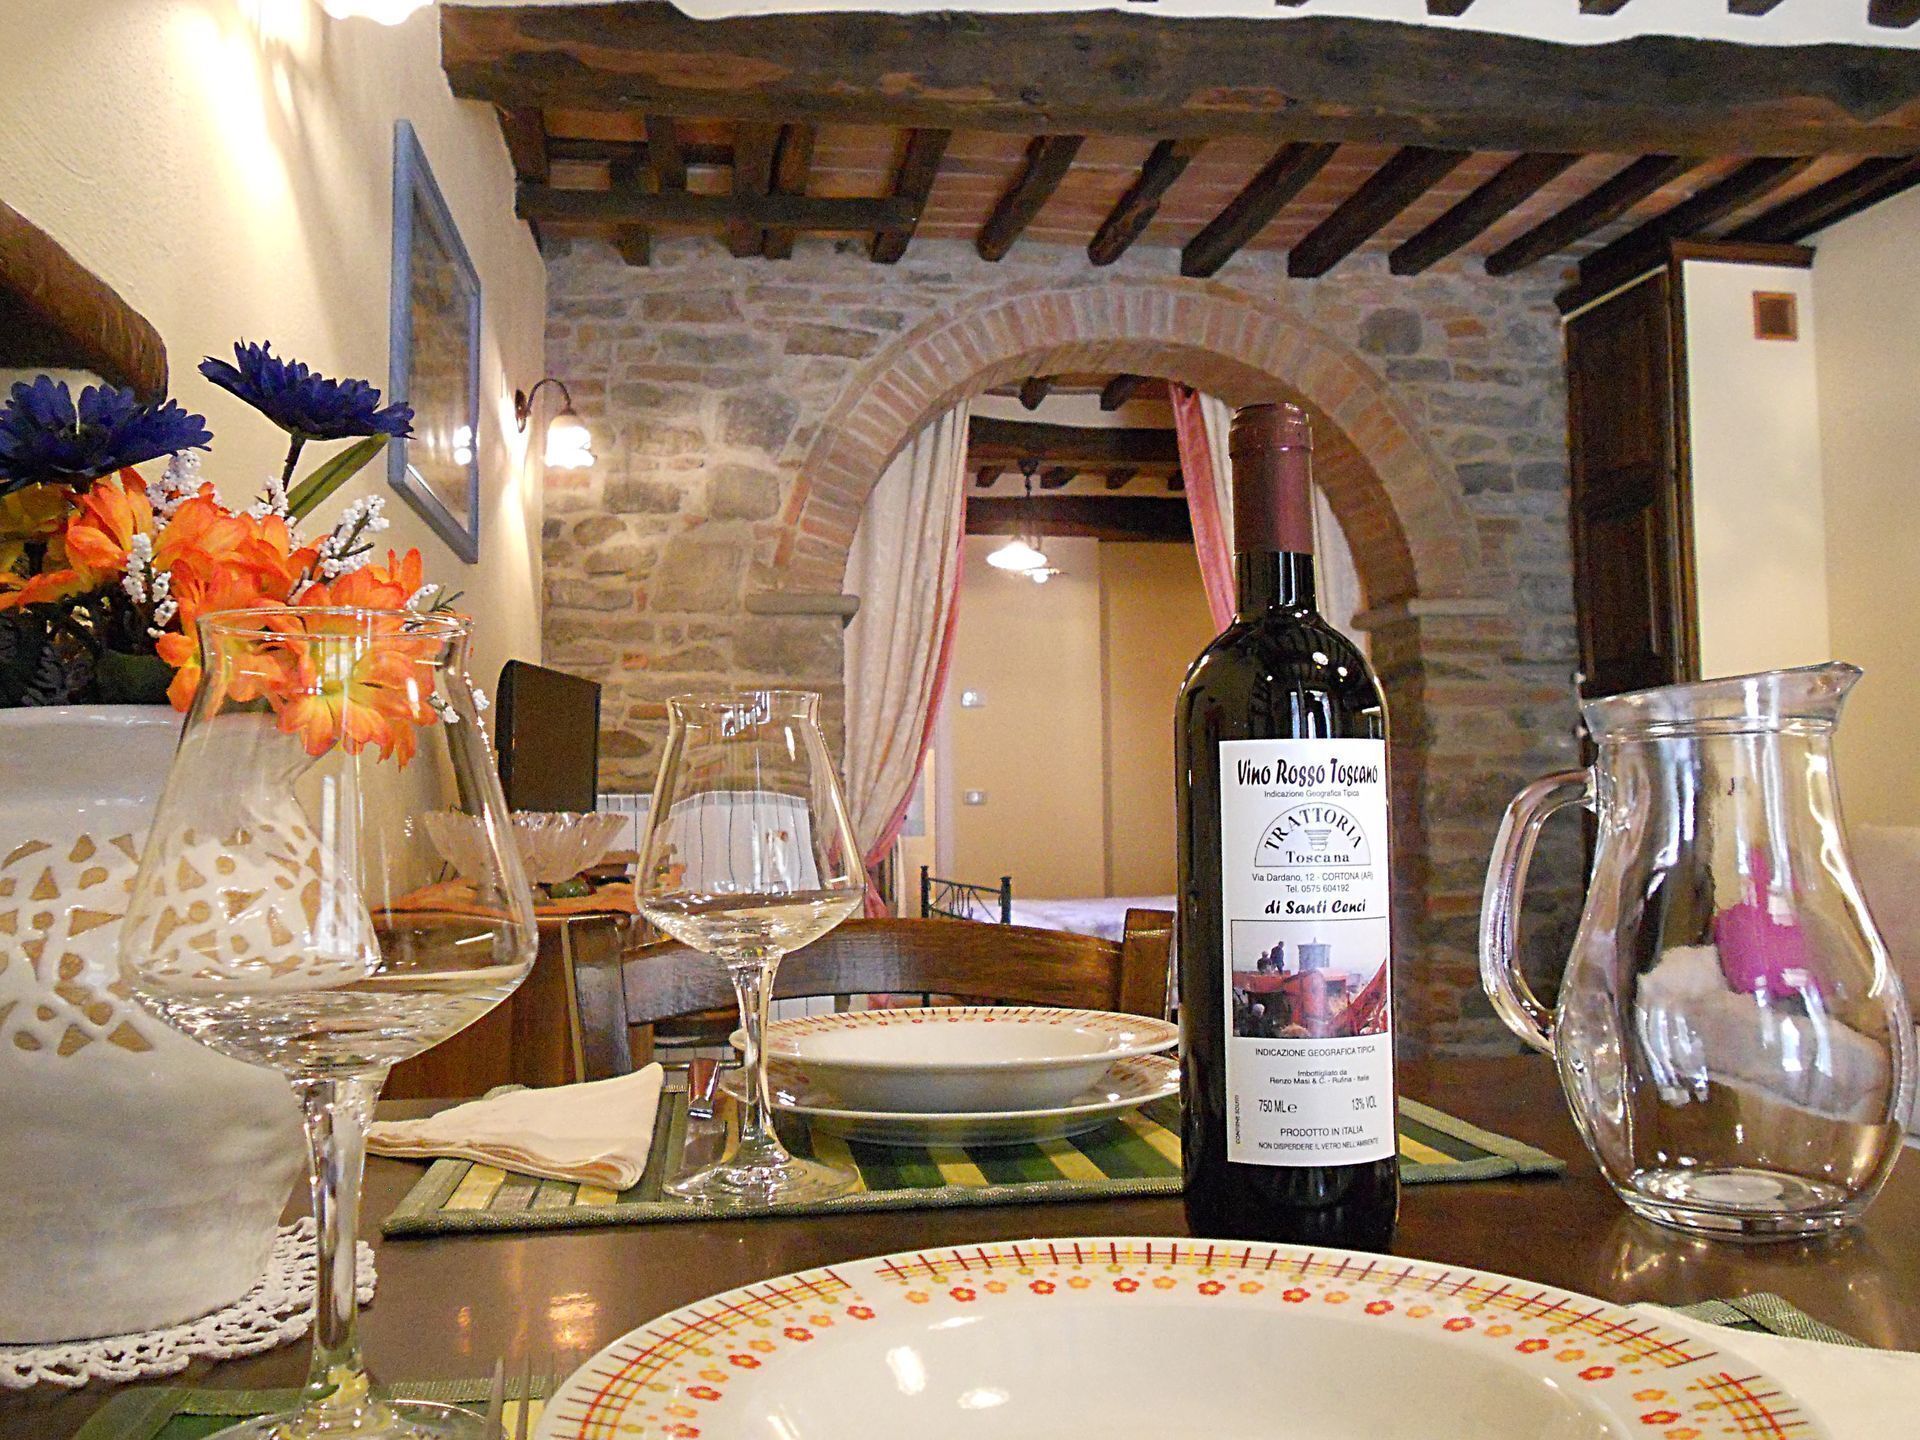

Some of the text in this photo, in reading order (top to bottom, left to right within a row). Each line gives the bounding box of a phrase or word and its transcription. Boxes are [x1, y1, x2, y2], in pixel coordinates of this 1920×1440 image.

[1237, 758, 1378, 787] Vino Rosso Toscano
[1264, 790, 1304, 798] Indicazione
[1306, 789, 1341, 798] Geografica
[1264, 807, 1362, 851] TRATTORIA
[1286, 850, 1350, 863] Toscana
[1252, 873, 1264, 881] Via
[1266, 873, 1303, 882] Dardano,
[1305, 873, 1315, 881] 12
[1322, 872, 1359, 881] CORTONA
[1286, 884, 1350, 893] Tel. 0575 604192
[1264, 899, 1366, 915] di Santi Cenci
[1255, 1048, 1306, 1057] INDICAZIONE
[1307, 1047, 1356, 1057] GEOGRAFICA
[1258, 1099, 1273, 1113] 750
[1274, 1099, 1287, 1113] ML
[1280, 1128, 1330, 1137] PRODOTTO
[1341, 1125, 1364, 1135] ITALIA
[1273, 1142, 1313, 1150] DISPERDERE
